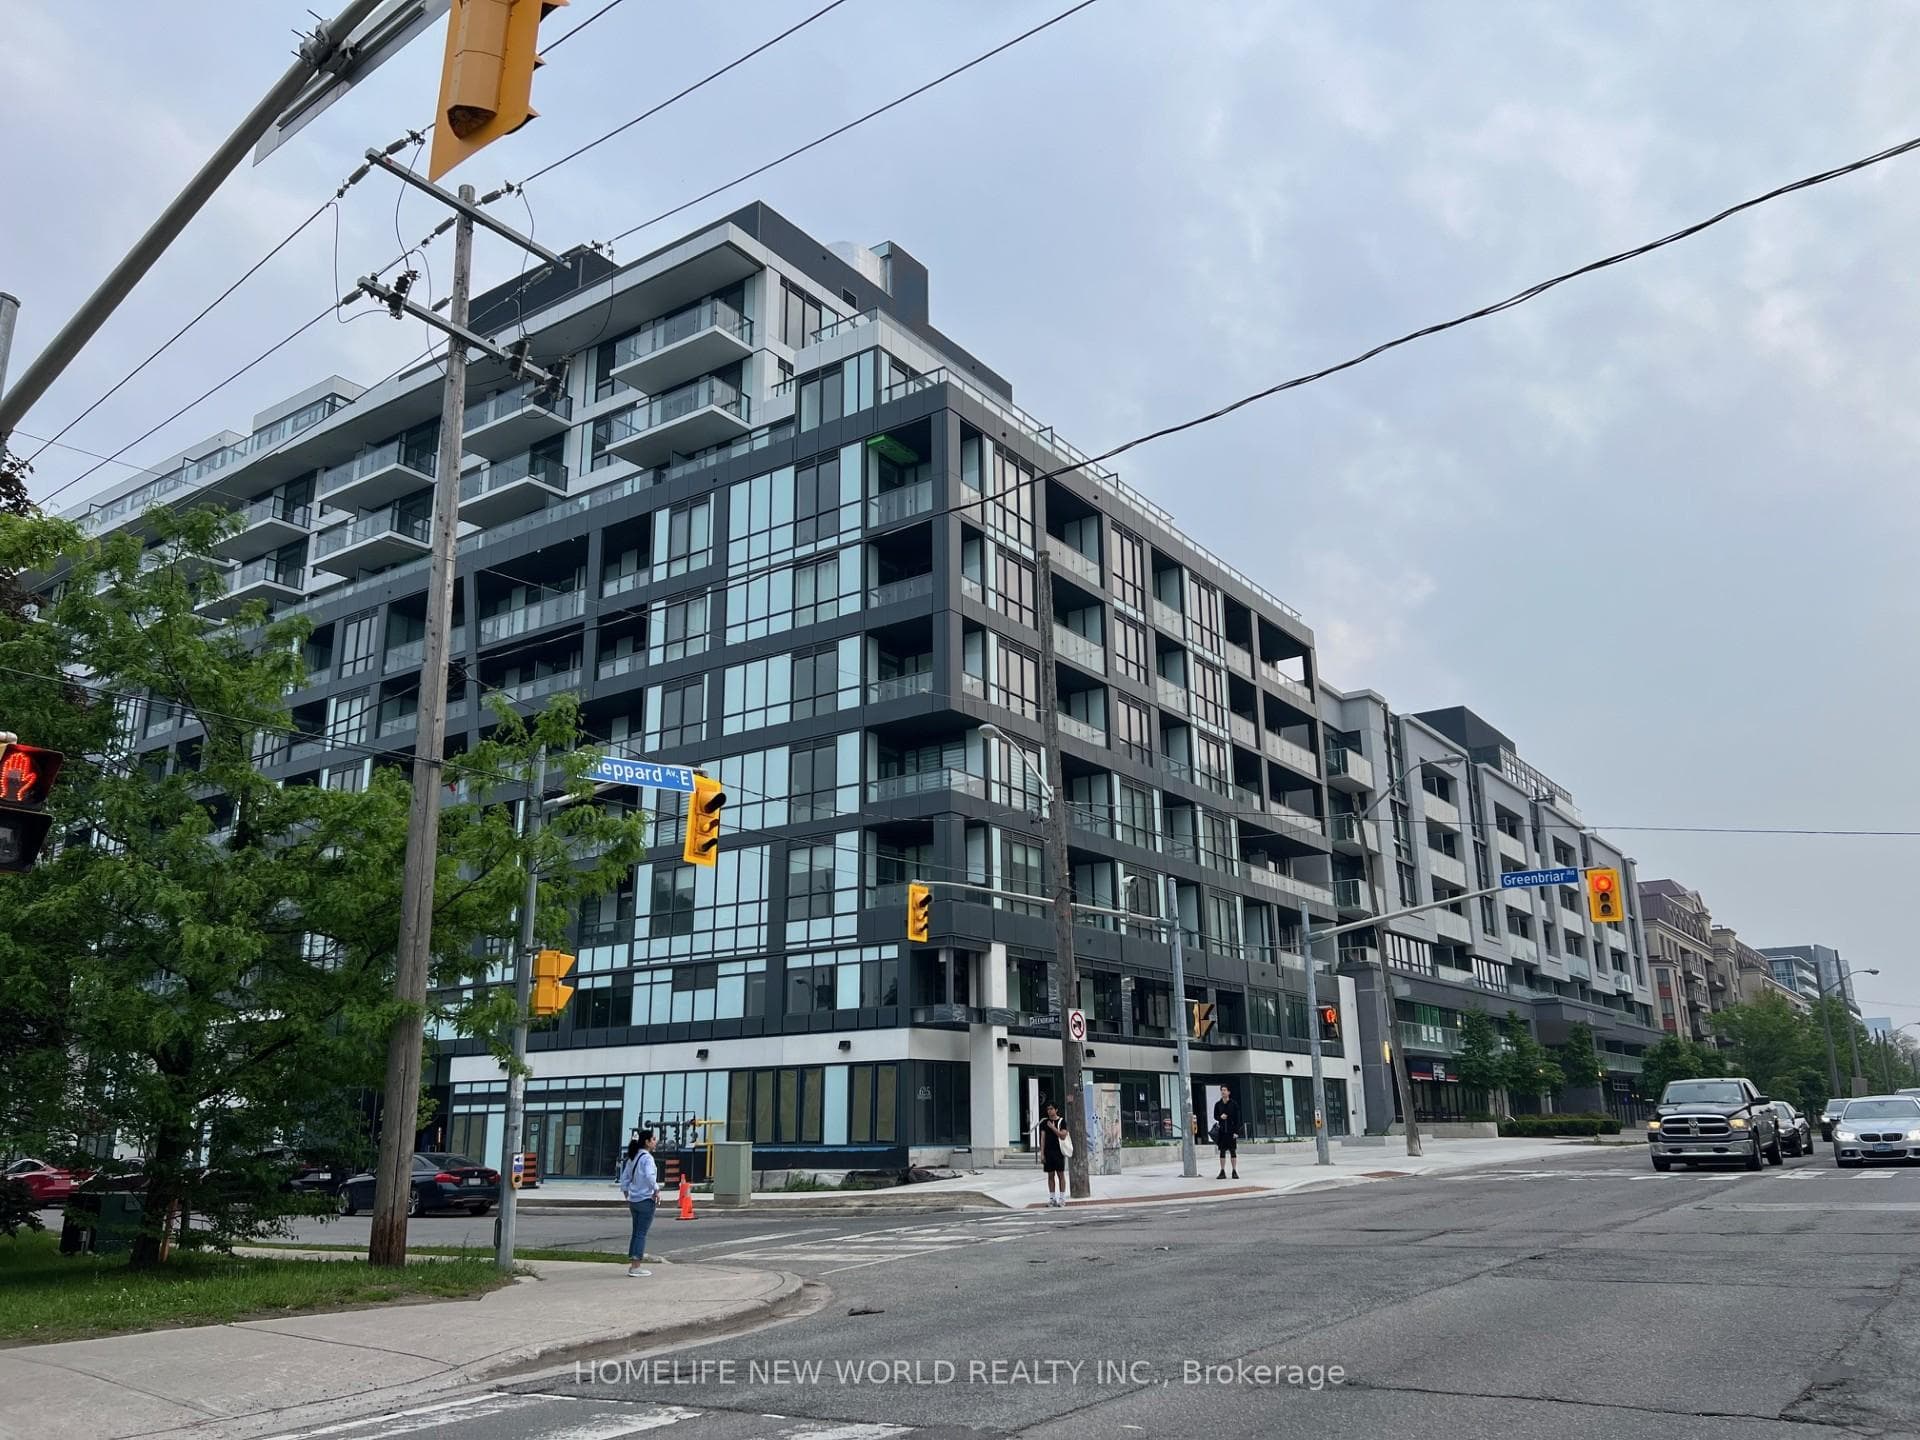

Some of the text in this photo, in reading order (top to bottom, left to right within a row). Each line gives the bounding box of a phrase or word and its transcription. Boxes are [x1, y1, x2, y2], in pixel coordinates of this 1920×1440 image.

[590, 762, 662, 783] eppard
[680, 769, 690, 786] E
[1503, 871, 1565, 886] Greenbriar
